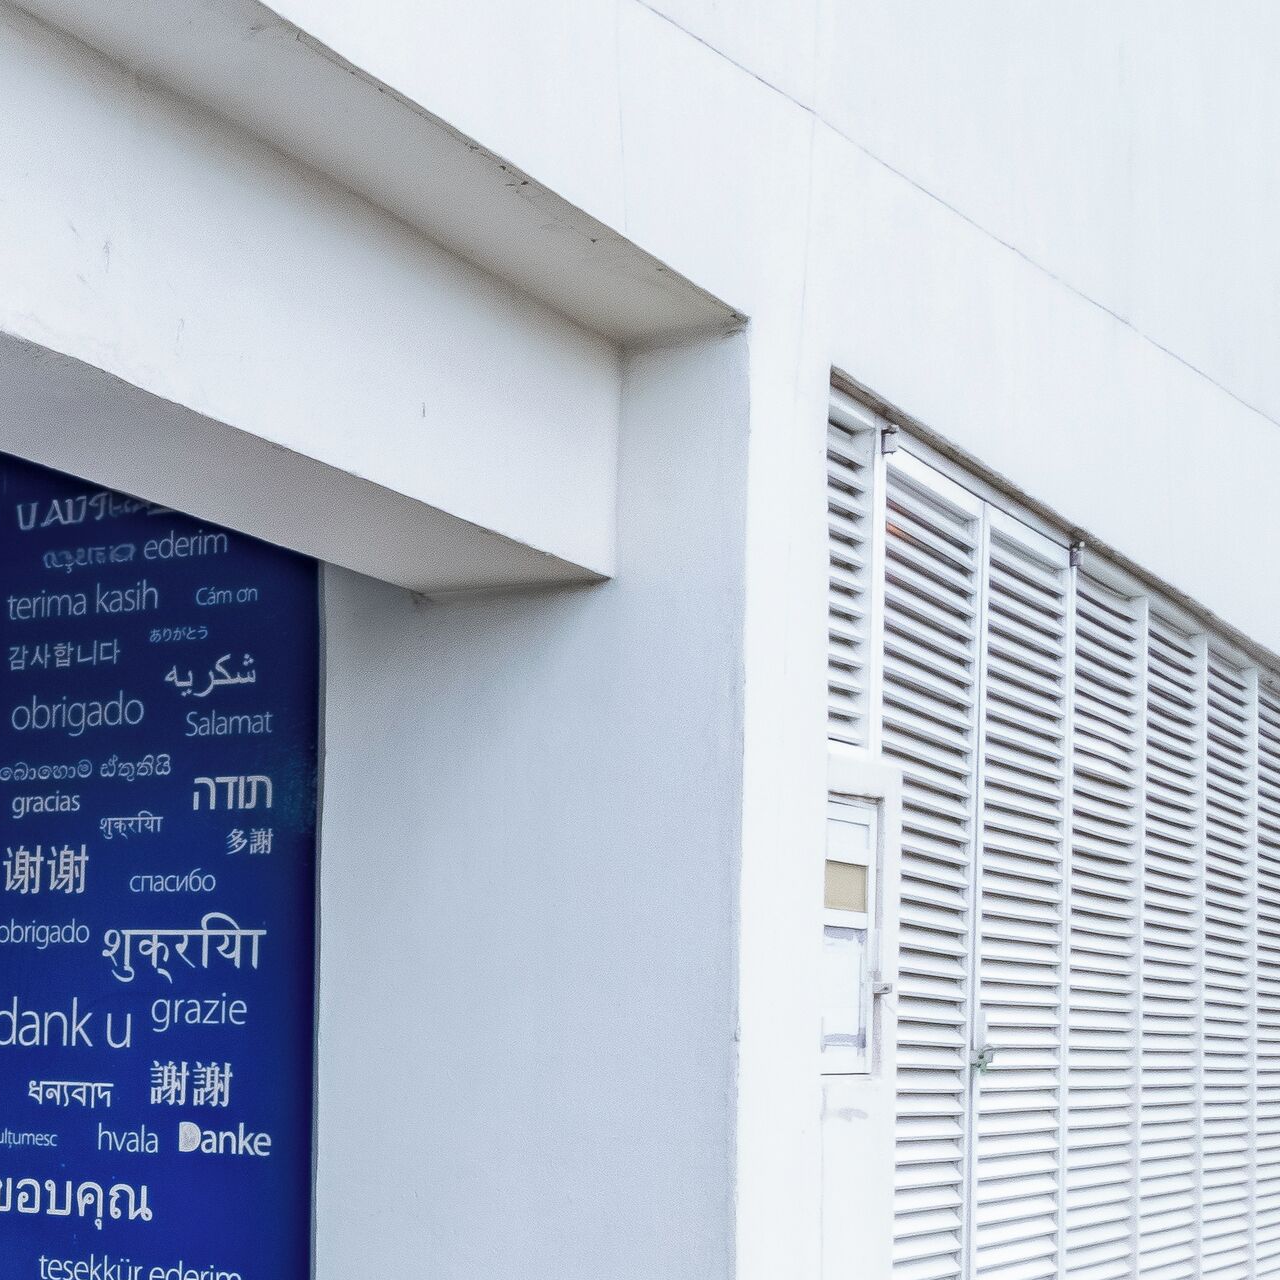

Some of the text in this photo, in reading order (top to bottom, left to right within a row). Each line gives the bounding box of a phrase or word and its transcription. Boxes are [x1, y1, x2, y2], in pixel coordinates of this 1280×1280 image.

[143, 529, 229, 560] ederim
[7, 579, 159, 620] terima kasih
[149, 626, 208, 643] ありがとう
[8, 638, 121, 671] 감사합니다
[11, 689, 144, 737] obrigado
[185, 709, 273, 737] Salamat
[11, 789, 81, 819] gracias
[192, 774, 273, 811] תודה
[225, 828, 274, 855] 多謝
[2, 844, 90, 894] 谢谢
[129, 868, 217, 893] спасибо
[151, 992, 248, 1033] grazie
[106, 1013, 132, 1049] u
[150, 1060, 234, 1108] 謝謝
[97, 1121, 272, 1157] hvala Danke
